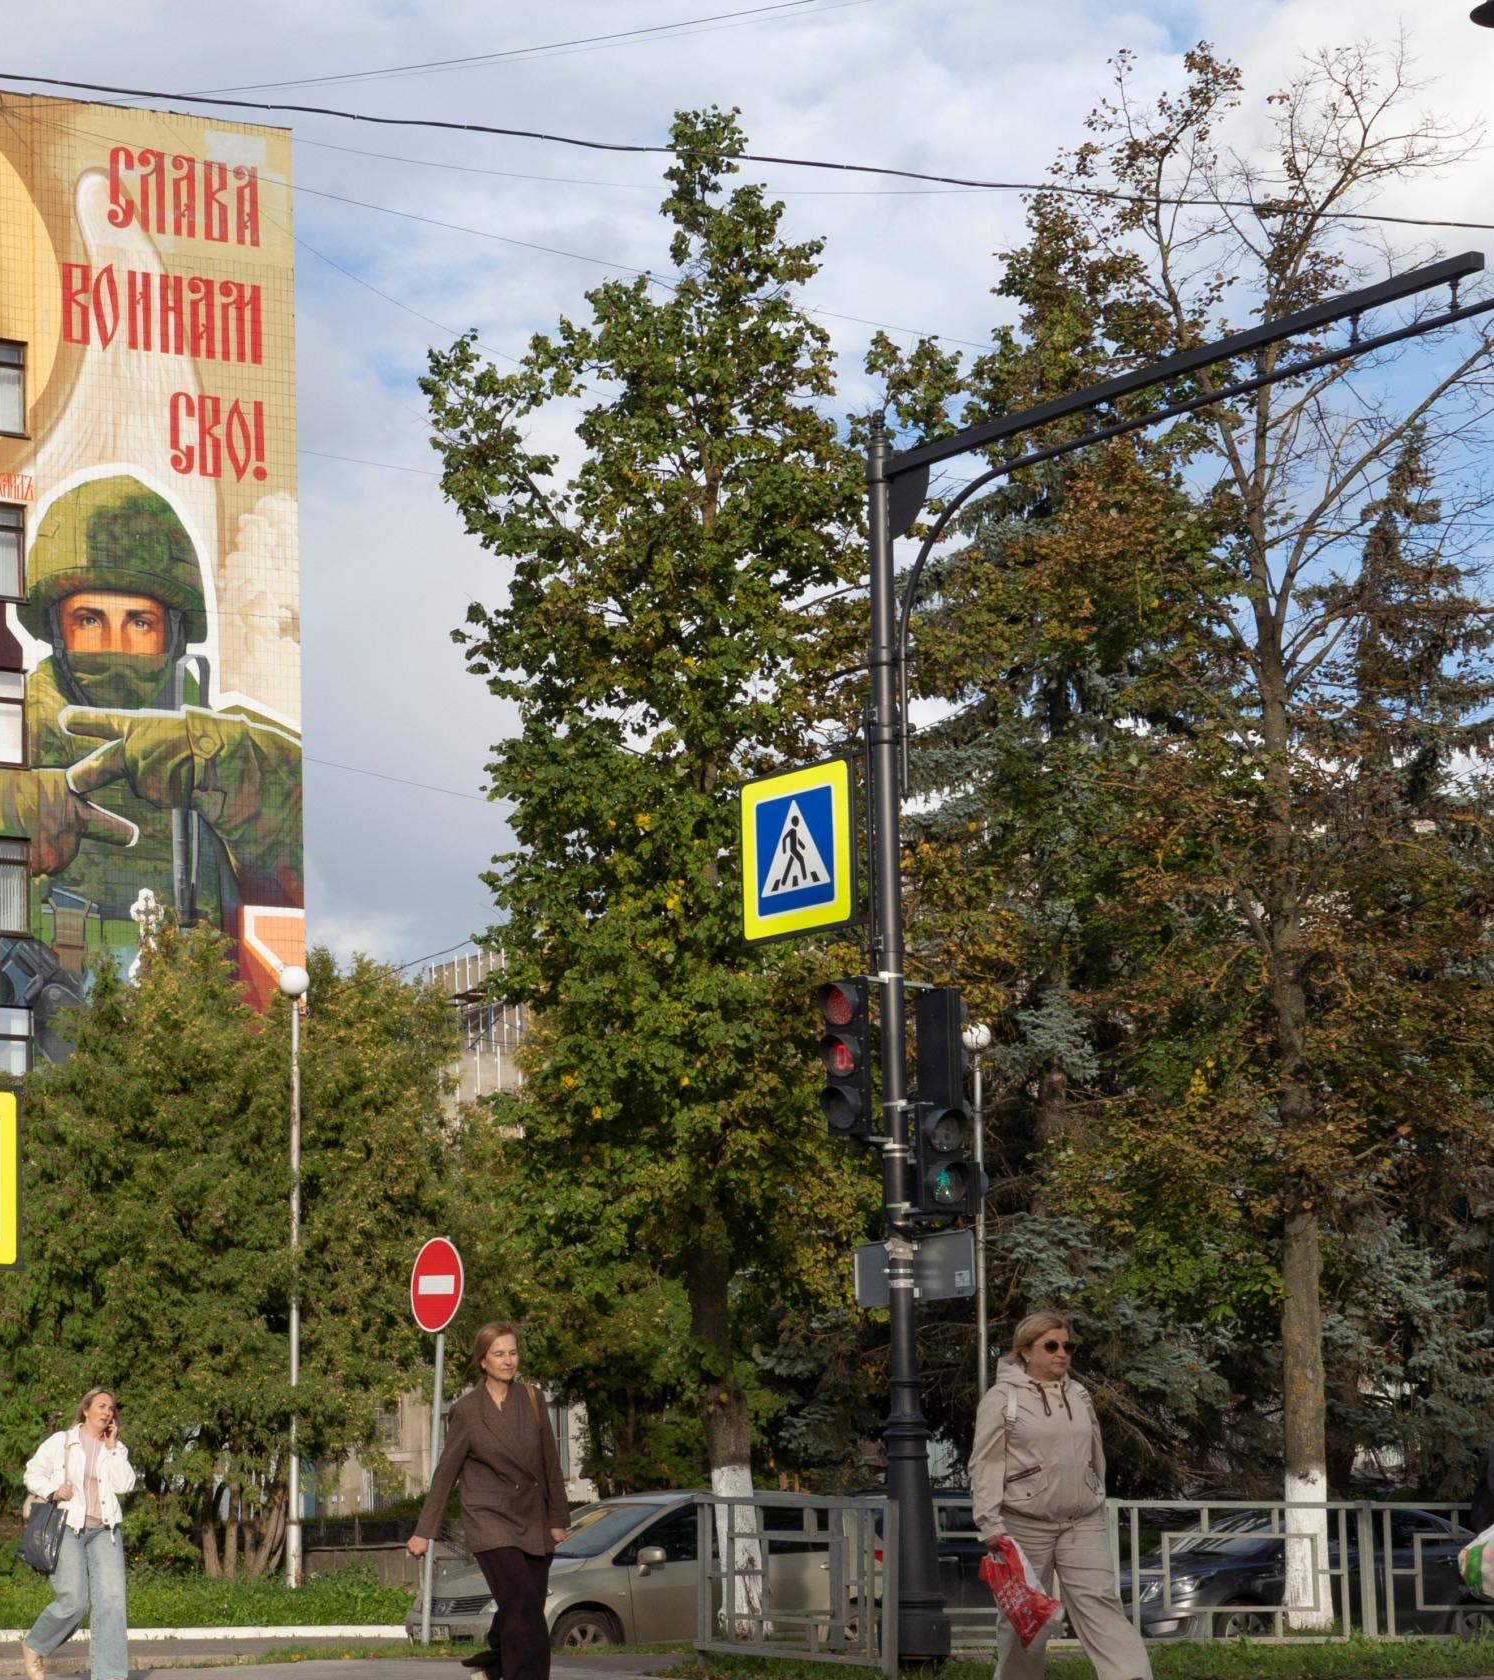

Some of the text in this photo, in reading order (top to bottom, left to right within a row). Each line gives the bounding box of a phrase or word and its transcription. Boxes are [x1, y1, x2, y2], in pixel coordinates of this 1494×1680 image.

[107, 146, 260, 247] СЛАВА
[62, 262, 262, 365] ВОИНАМ
[169, 391, 267, 484] СВО!
